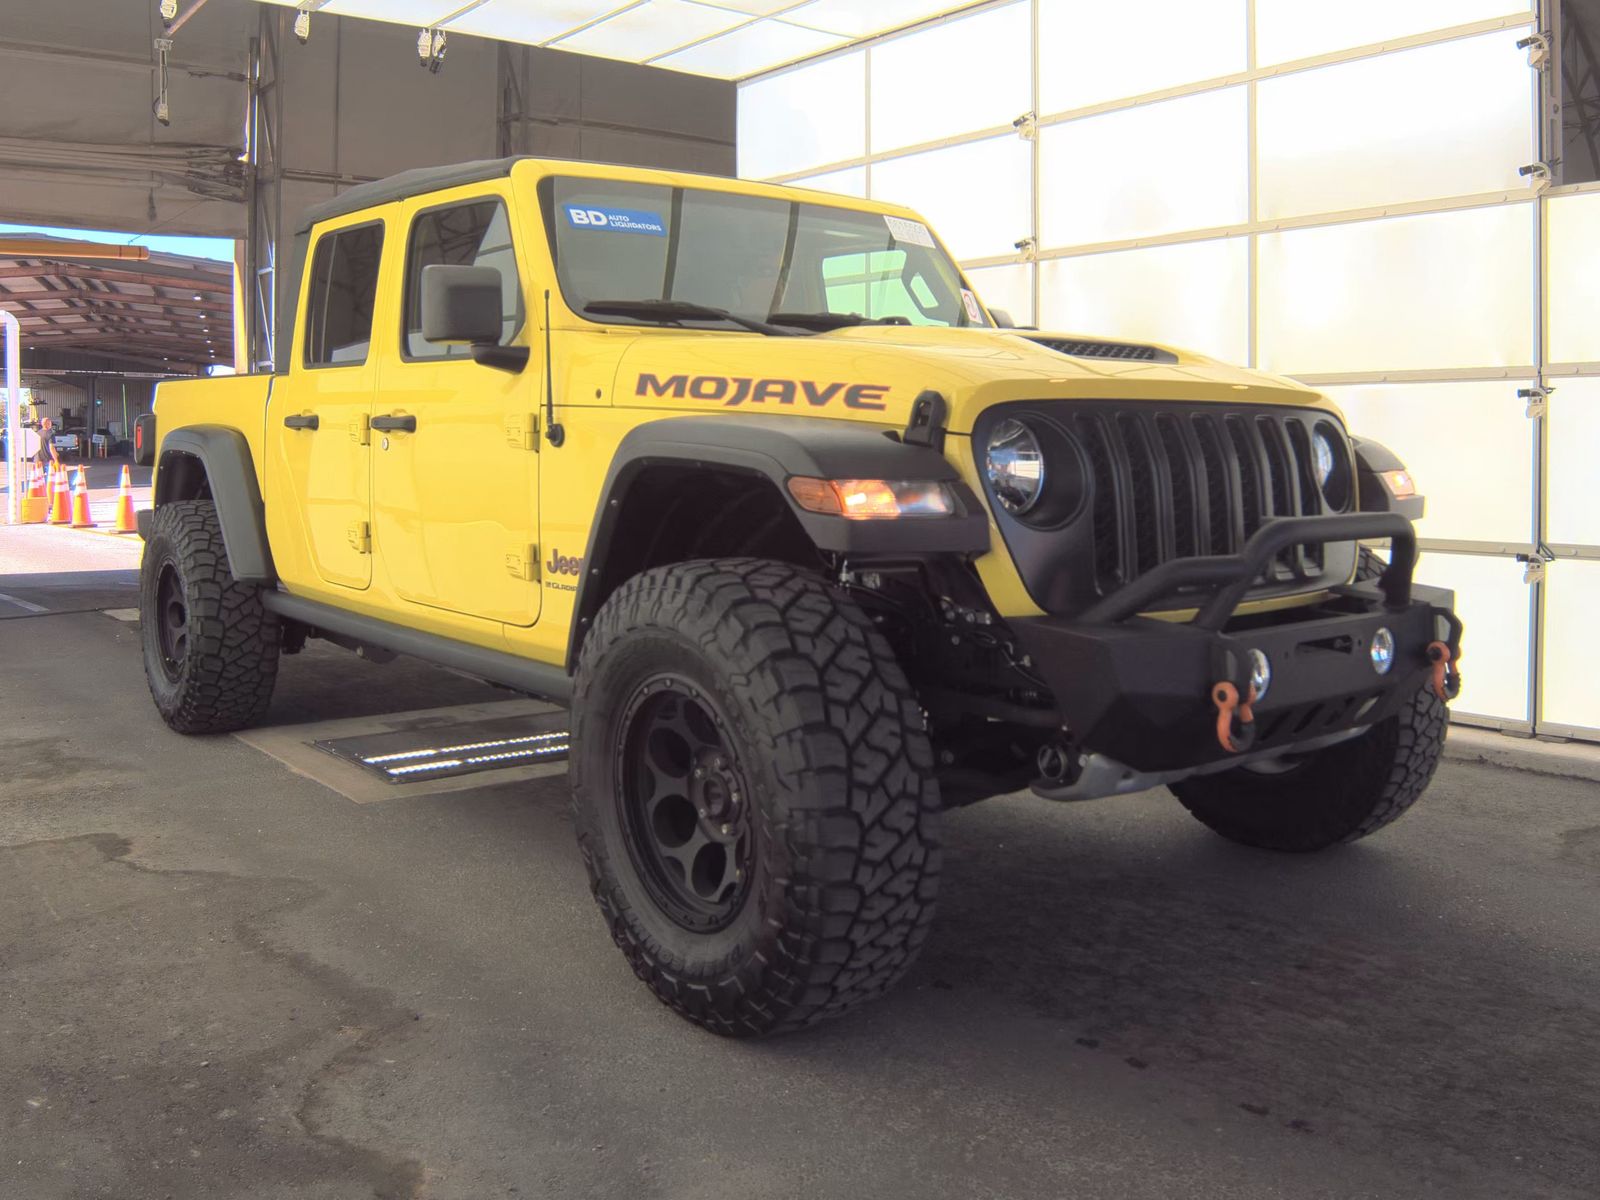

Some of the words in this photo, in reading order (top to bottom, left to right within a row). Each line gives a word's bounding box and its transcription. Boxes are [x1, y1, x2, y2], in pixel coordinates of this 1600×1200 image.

[569, 209, 608, 225] BD
[610, 221, 662, 231] LIQUIDATORS
[635, 373, 892, 411] MOJAVE
[546, 548, 584, 576] Jee
